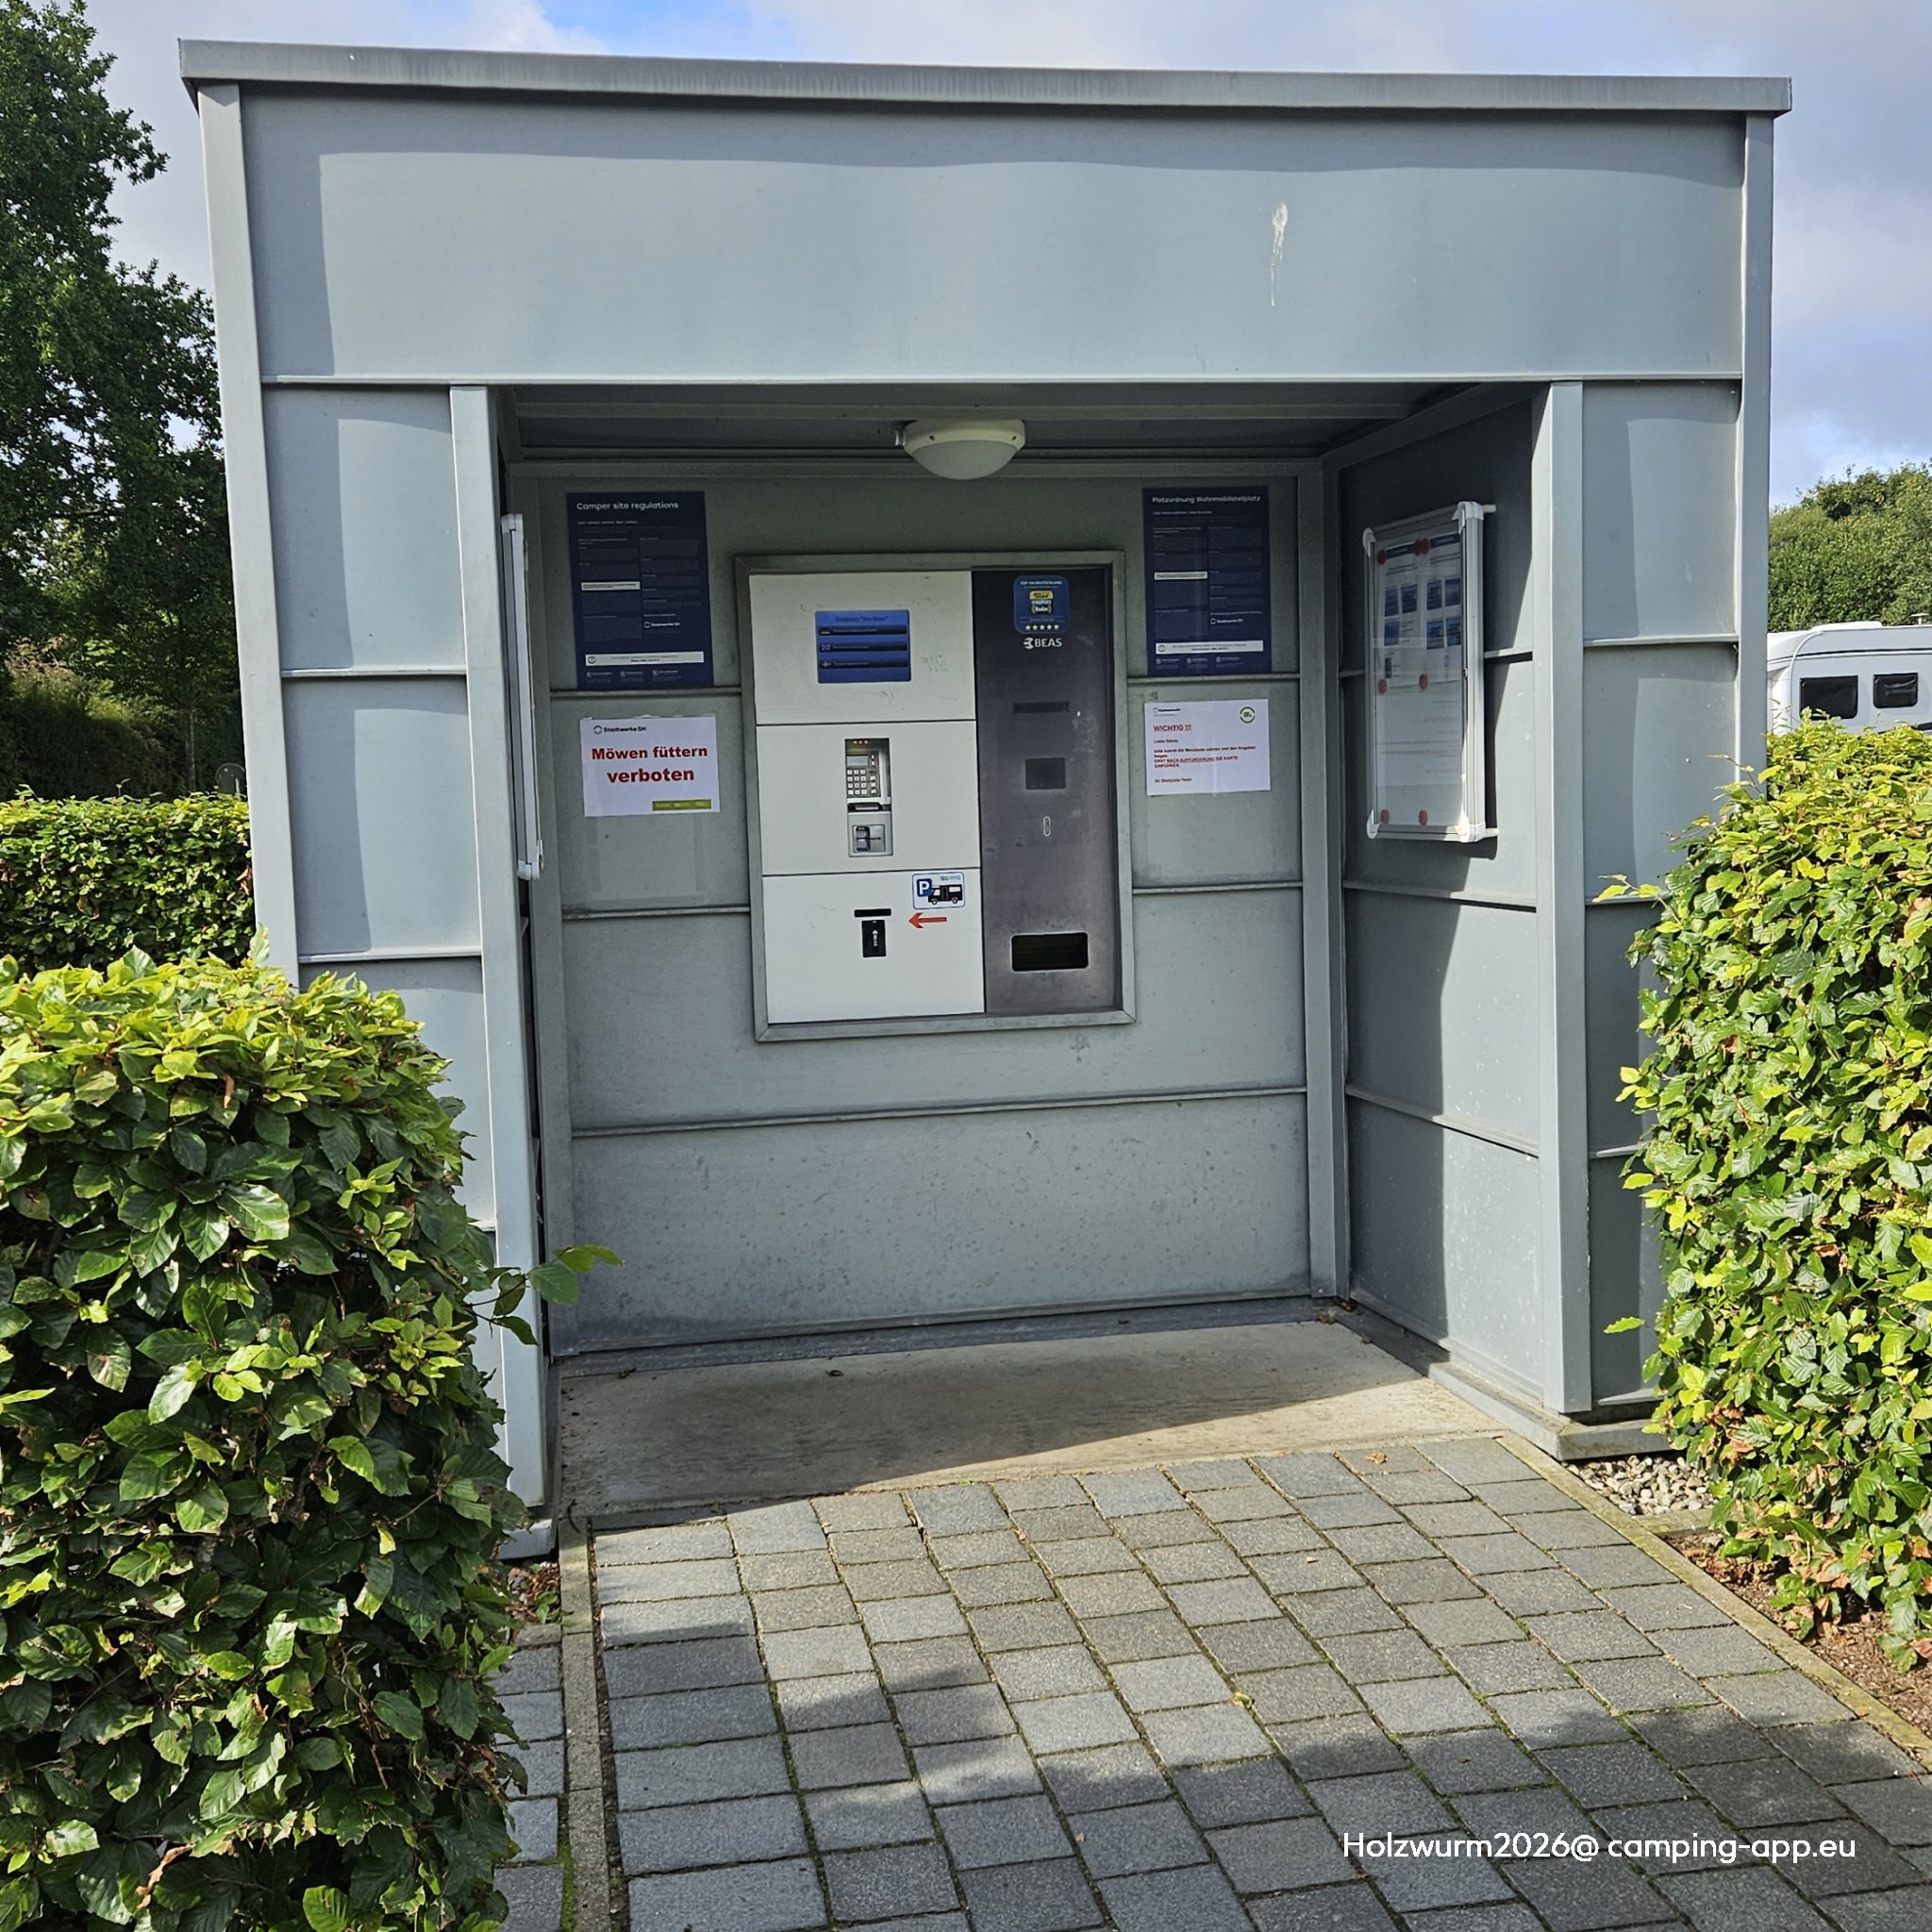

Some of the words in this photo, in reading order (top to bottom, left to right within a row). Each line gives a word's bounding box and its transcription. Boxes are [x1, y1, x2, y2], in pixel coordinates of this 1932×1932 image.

[576, 502, 610, 511] Camper
[631, 501, 679, 511] regulations
[1034, 638, 1062, 647] BEAS
[591, 748, 648, 760] Möwen
[653, 745, 708, 758] füttern
[607, 768, 694, 783] verboten
[918, 880, 930, 895] P
